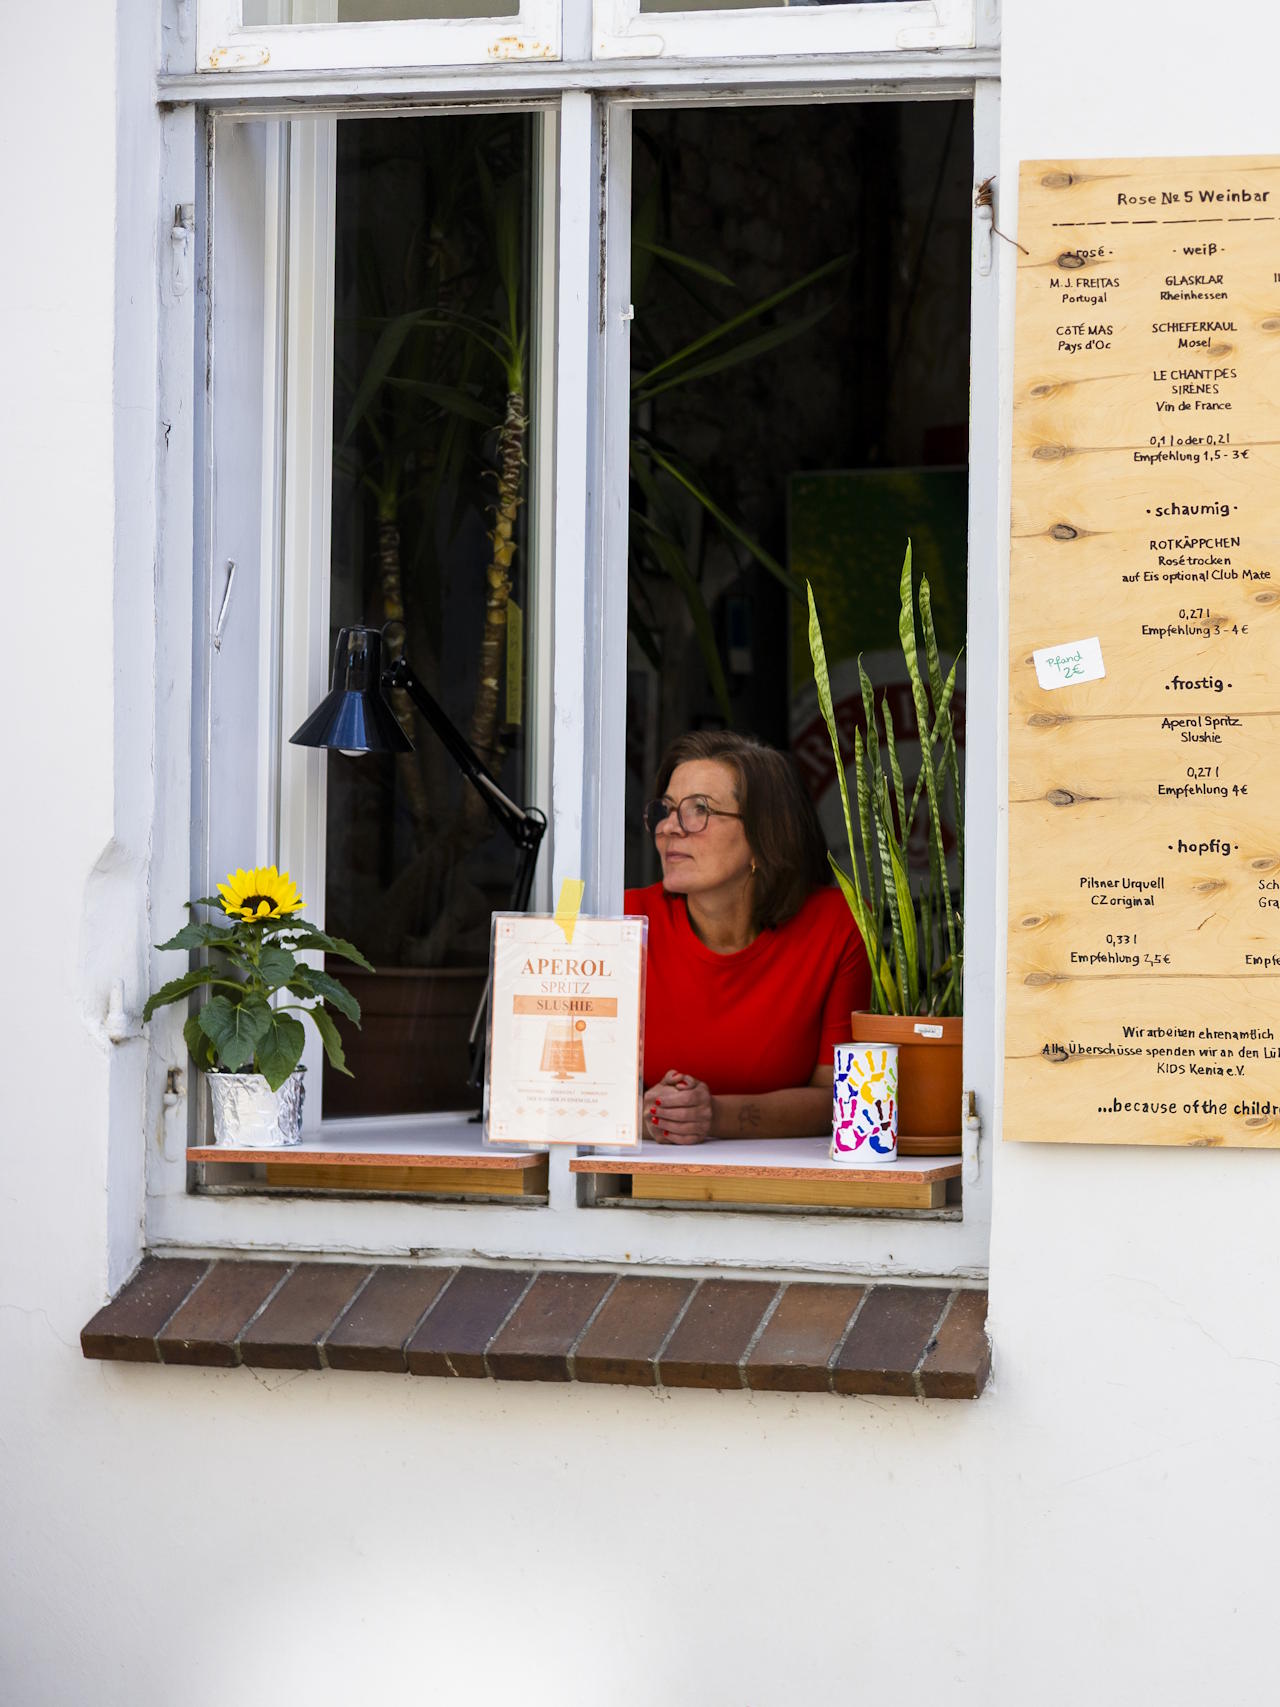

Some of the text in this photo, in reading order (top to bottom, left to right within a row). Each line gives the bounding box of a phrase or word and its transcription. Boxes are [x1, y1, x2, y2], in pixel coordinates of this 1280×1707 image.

[1117, 192, 1157, 206] Rose
[1183, 190, 1193, 203] 5
[1198, 188, 1270, 203] Weinbar
[1076, 277, 1120, 289] FREITAS
[1165, 274, 1224, 286] GLASKLAR
[1062, 291, 1107, 306] Portugal
[1160, 289, 1228, 301] Rheinhessen
[1087, 324, 1114, 336] MAS
[1151, 321, 1238, 334] SCHIEFERKAUL
[1057, 339, 1111, 355] Pays d'Oc
[1178, 338, 1211, 349] Mosel
[1153, 370, 1167, 382] LE
[1170, 369, 1213, 381] CHANT
[1155, 400, 1232, 412] Vin de France
[1150, 436, 1166, 447] 0,1
[1177, 435, 1204, 445] oder
[1133, 450, 1200, 466] Empfehlung
[1155, 501, 1230, 518] schaumig
[1149, 535, 1241, 551] ROTKÄPPCHEN
[1158, 554, 1232, 567] Rosé trocken
[1121, 568, 1271, 584] auf Eis optional Club Mate
[1142, 625, 1210, 638] Empfehlung
[1047, 650, 1083, 672] Pfand
[1064, 664, 1085, 679] 2€
[1170, 675, 1224, 693] frostig
[1161, 716, 1243, 729] Aperol Spritz
[1180, 731, 1223, 744] Slushie
[1157, 783, 1229, 800] Empfehlung
[1177, 838, 1231, 857] hopfig
[1079, 876, 1165, 893] Pilsner Urquell
[1090, 894, 1155, 910] CZ original
[1070, 951, 1140, 967] Empfehlung
[521, 958, 613, 977] APEROL
[541, 981, 590, 994] SPRITZ
[536, 999, 593, 1012] SLUSHIE
[1122, 1025, 1274, 1041] Wir arbeiten ehrenamtlich
[1069, 1041, 1142, 1056] Überschüsse
[1146, 1046, 1194, 1059] spenden
[1198, 1047, 1218, 1058] wir
[1220, 1048, 1234, 1058] an
[1238, 1047, 1259, 1059] den
[1156, 1062, 1186, 1075] KIDS
[1189, 1061, 1225, 1077] Kenia
[1183, 1100, 1201, 1114] of
[1202, 1100, 1227, 1114] the
